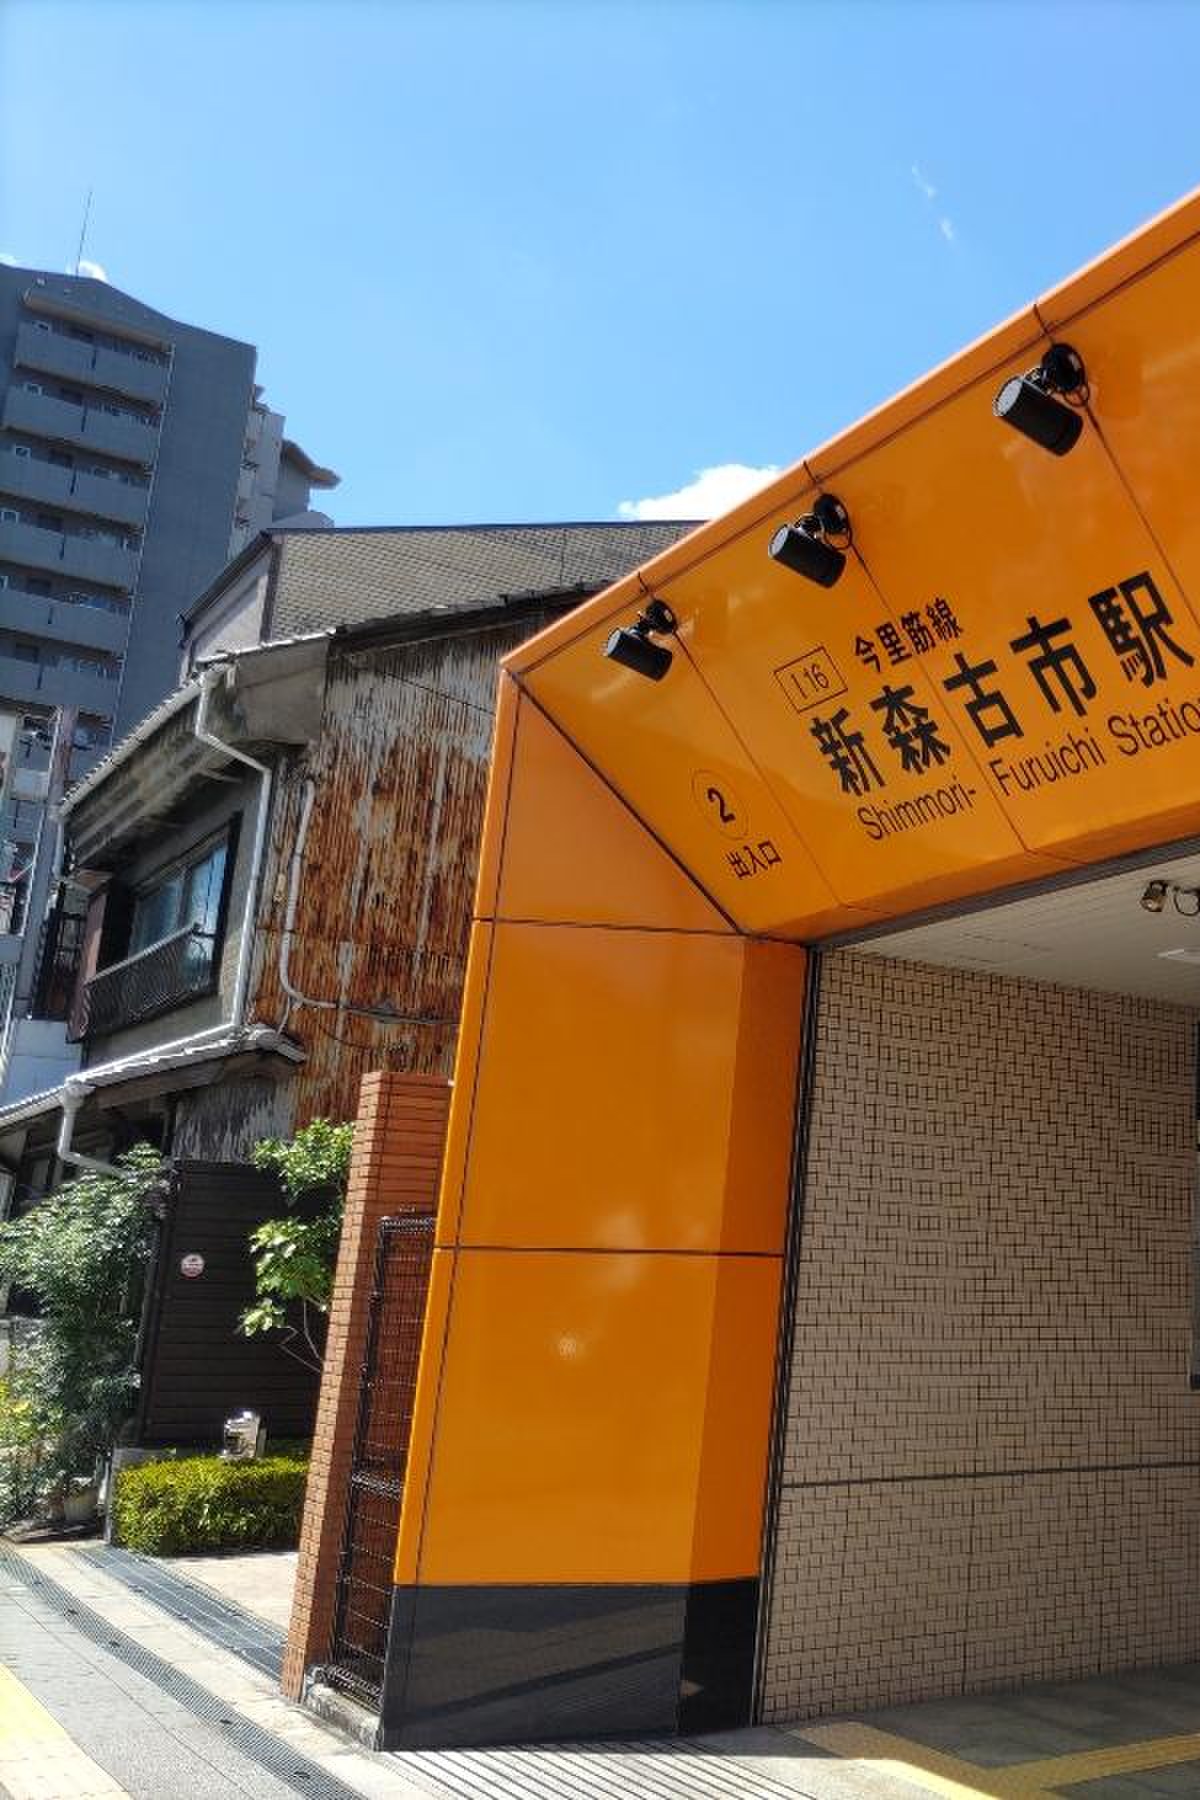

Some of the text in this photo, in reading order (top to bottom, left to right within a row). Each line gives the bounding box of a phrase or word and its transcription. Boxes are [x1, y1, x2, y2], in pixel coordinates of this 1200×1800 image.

[855, 598, 963, 672] 今里筋線
[809, 570, 1194, 797] 新森古市駅
[707, 787, 736, 823] 2
[857, 774, 977, 841] Shimmori-
[989, 726, 1106, 797] Furuichi
[725, 840, 782, 878] 出入口
